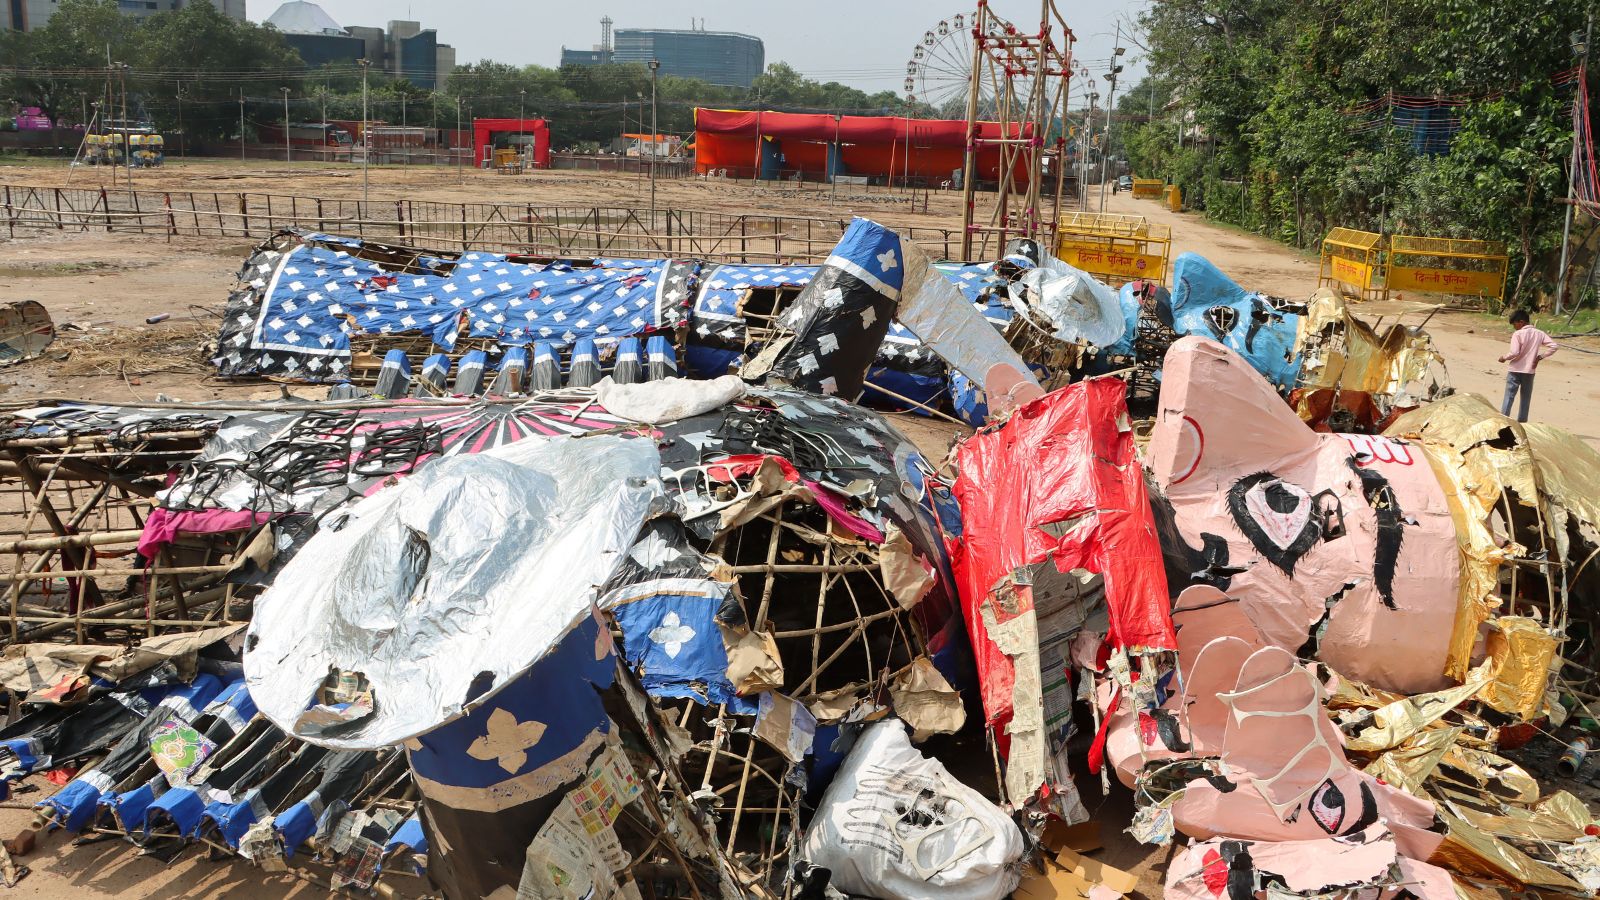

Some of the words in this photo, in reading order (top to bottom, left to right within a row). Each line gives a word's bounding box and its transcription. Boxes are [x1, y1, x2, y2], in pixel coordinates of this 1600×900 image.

[1078, 250, 1104, 264] दिल्ली
[1107, 253, 1134, 266] पुलिस
[1414, 270, 1440, 283] दिल्ली
[1442, 273, 1469, 286] पुलिस
